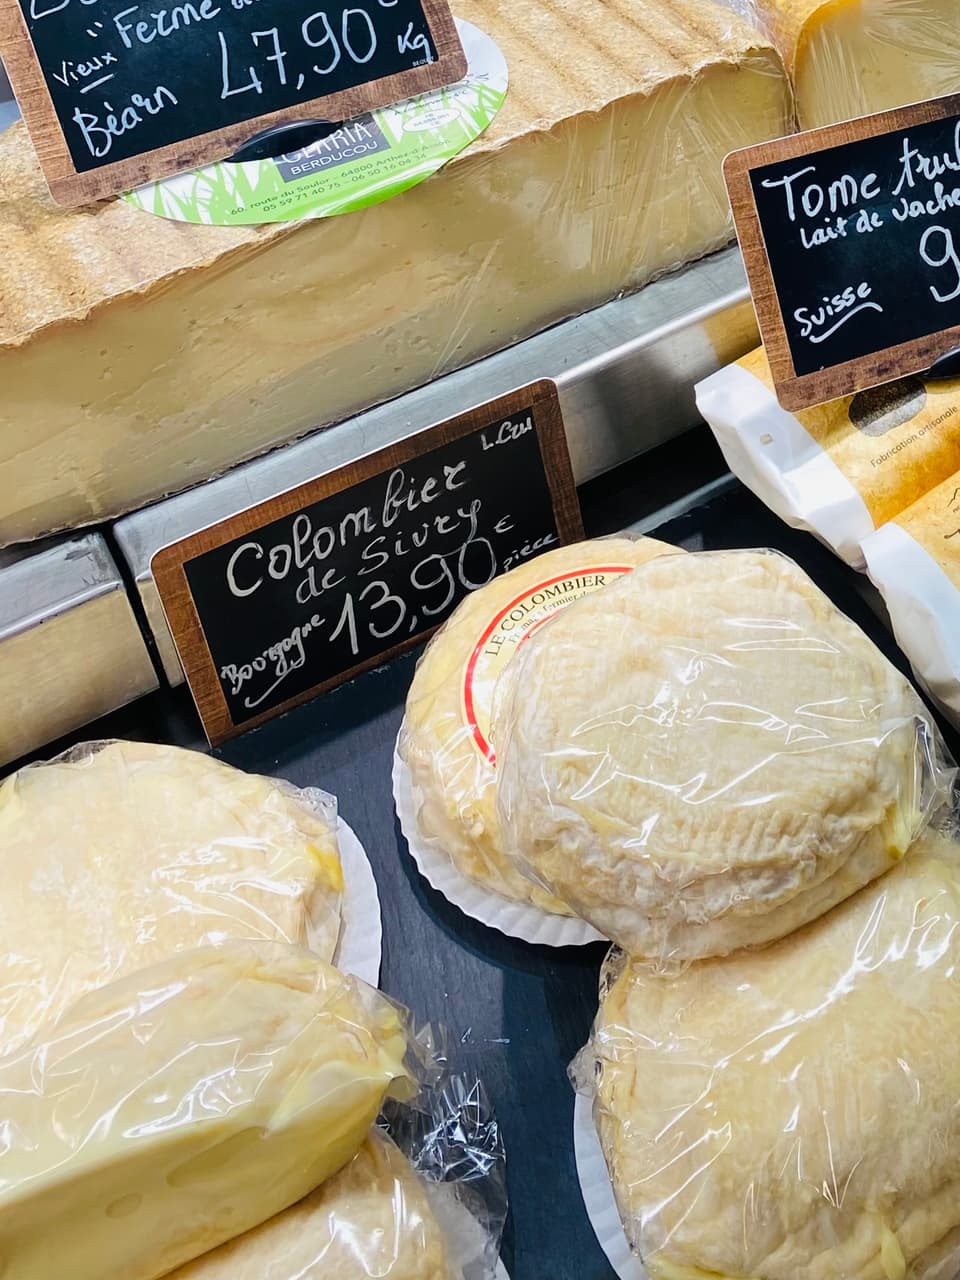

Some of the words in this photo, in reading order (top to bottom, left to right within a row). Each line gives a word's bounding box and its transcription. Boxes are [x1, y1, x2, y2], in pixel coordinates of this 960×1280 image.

[73, 84, 179, 158] Béarn
[290, 141, 378, 175] BERDUCOU
[762, 166, 880, 220] Tome
[800, 218, 848, 249] lait
[856, 204, 884, 233] de
[794, 281, 872, 337] Suisse
[870, 433, 918, 469] Fabrication
[918, 405, 959, 437] artisanale
[226, 459, 467, 598] Colombier
[296, 565, 345, 606] de
[357, 498, 483, 577] Sivry
[485, 633, 507, 656] LE
[500, 574, 606, 632] COLOMBIER
